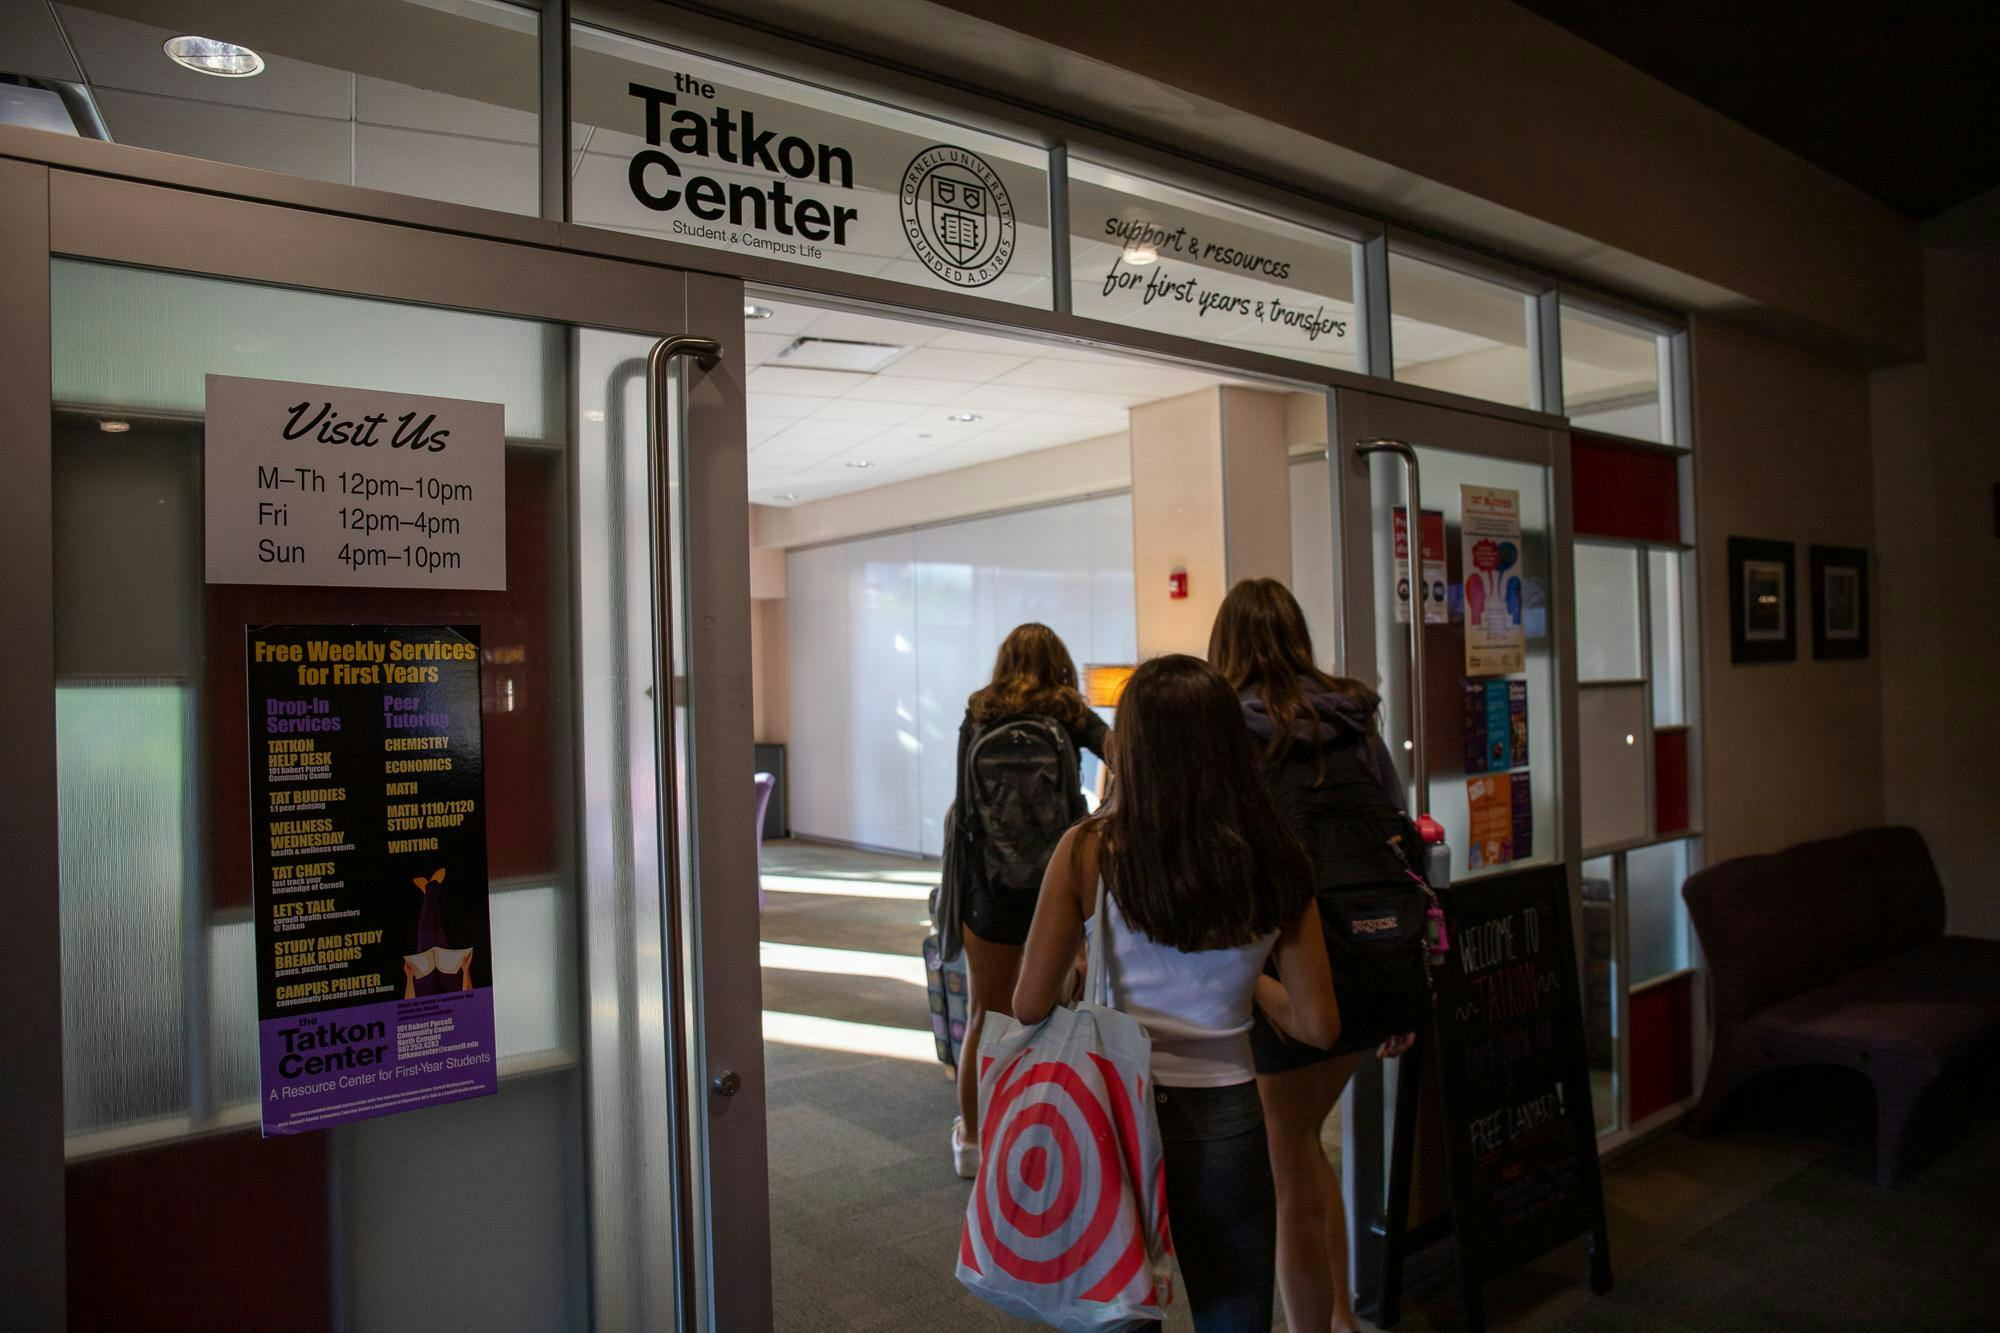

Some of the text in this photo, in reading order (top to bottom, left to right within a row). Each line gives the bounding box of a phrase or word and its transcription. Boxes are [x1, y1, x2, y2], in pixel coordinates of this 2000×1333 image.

[674, 72, 715, 99] the
[629, 82, 853, 189] Tatkon
[628, 150, 858, 246] Center
[904, 151, 1012, 229] CORNELL UNIVERSITY
[673, 220, 822, 259] Student & Campus Life
[1105, 217, 1290, 279] support & resources
[906, 219, 1011, 283] FOUNDED A.D. 1865
[1103, 257, 1347, 341] for first years & transfers
[282, 401, 450, 452] Visit Us
[258, 503, 288, 526] Fri
[258, 539, 305, 563] Sun
[254, 640, 477, 663] Free Weekly Services
[298, 663, 439, 686] for First Years
[384, 696, 419, 712] Peer
[267, 716, 341, 734] Services
[384, 712, 449, 729] Tutoring
[268, 739, 315, 753] TATKON
[384, 736, 449, 751] CHEMISTRY
[268, 752, 332, 768] HELP DESK
[385, 758, 452, 774] ECONOMICS
[269, 772, 332, 782] Community Center
[281, 766, 304, 774] Robert
[269, 787, 346, 804] TAT BUDDIES
[386, 782, 418, 796] MATH
[297, 802, 326, 811] advising
[387, 800, 475, 818] MATH 1110/1120
[270, 818, 333, 835] WELLNESS
[387, 814, 464, 832] STUDY GROUP
[271, 831, 345, 849] WEDNESDAY
[388, 837, 439, 854] WRITING
[271, 849, 294, 857] health
[301, 846, 332, 854] wellness
[272, 862, 336, 880] TAT CHATS
[273, 898, 335, 918] LET'S TALK
[282, 923, 306, 932] Tatkon
[274, 930, 383, 955] STUDY AND STUDY
[1458, 906, 1540, 976] WELCOME TO
[275, 946, 362, 970] BREAK ROOMS
[276, 973, 382, 1000] CAMPUS PRINTER
[299, 1018, 318, 1026] the
[279, 1020, 385, 1053] Tatkon
[279, 1045, 388, 1078] Center
[269, 1088, 279, 1102] A
[282, 1080, 336, 1099] Resource
[340, 1073, 376, 1088] Center
[379, 1070, 392, 1081] for
[396, 1061, 444, 1078] First-Year
[446, 1053, 491, 1069] Students
